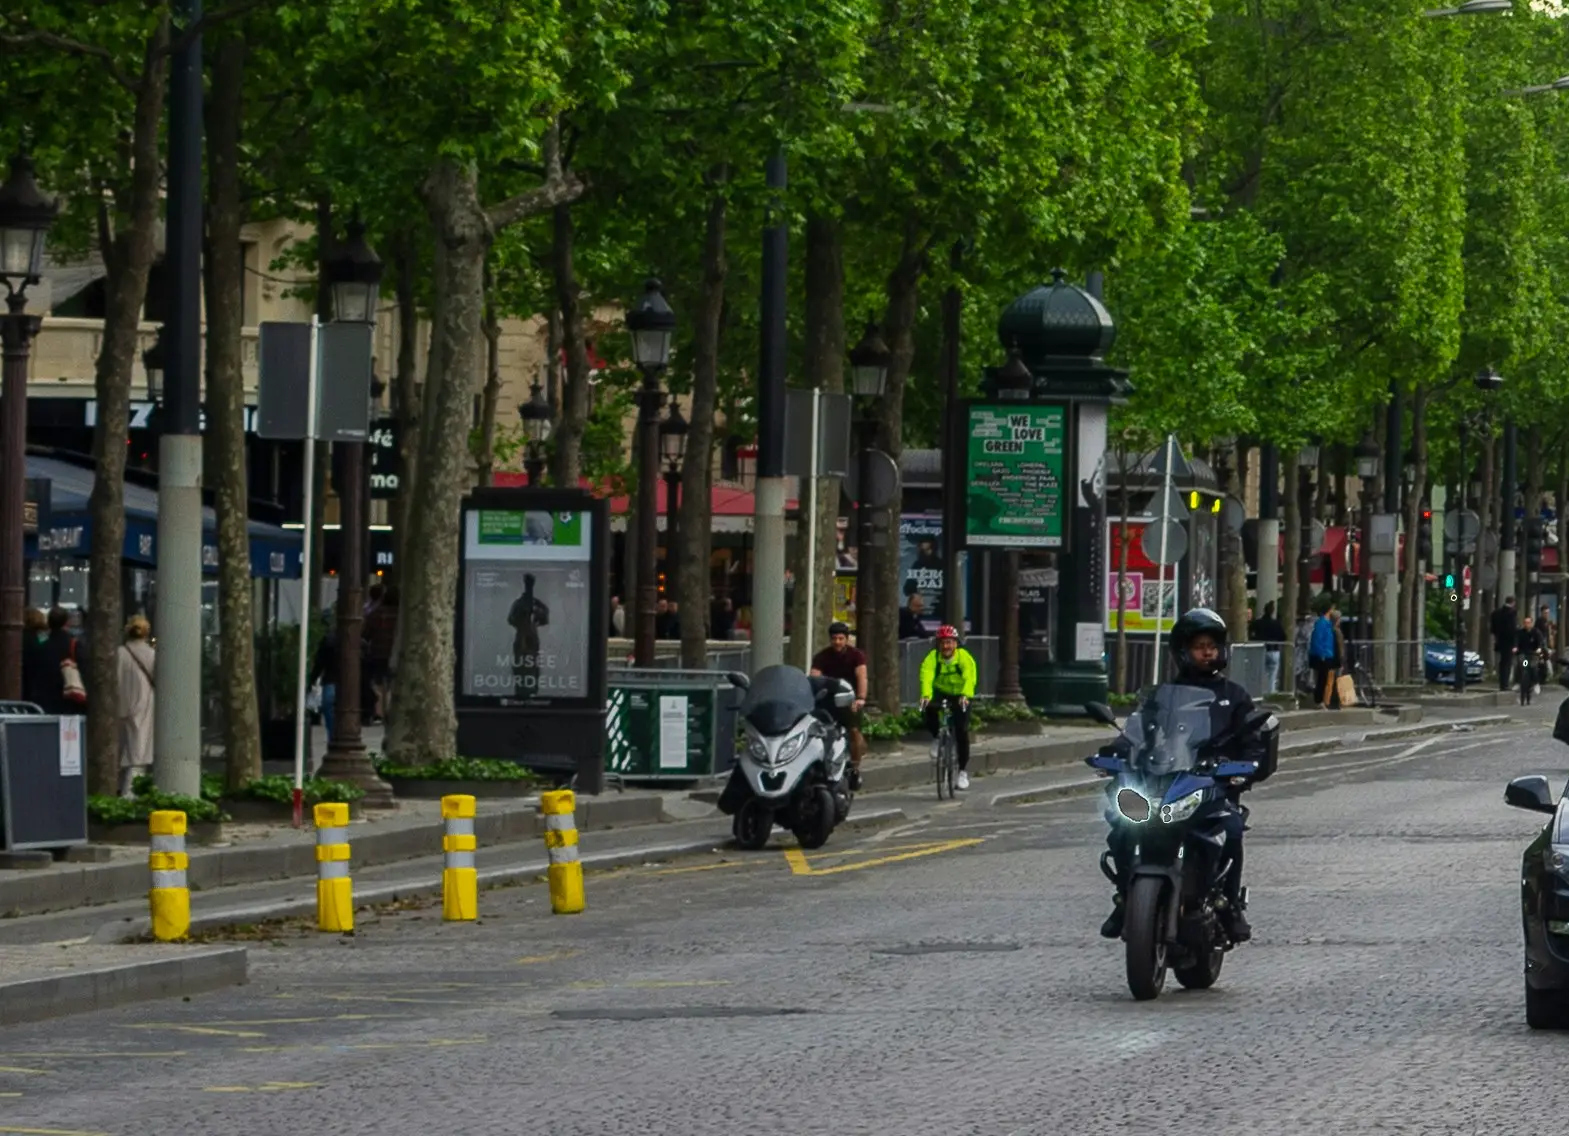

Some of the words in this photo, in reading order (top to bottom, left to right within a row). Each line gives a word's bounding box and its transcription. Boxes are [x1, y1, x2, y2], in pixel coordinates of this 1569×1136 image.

[1009, 415, 1029, 427] WE
[1014, 428, 1042, 440] LOVE
[985, 440, 1022, 452] GREEN
[495, 650, 557, 669] MUSÉE
[474, 674, 579, 689] BOURDELLE
